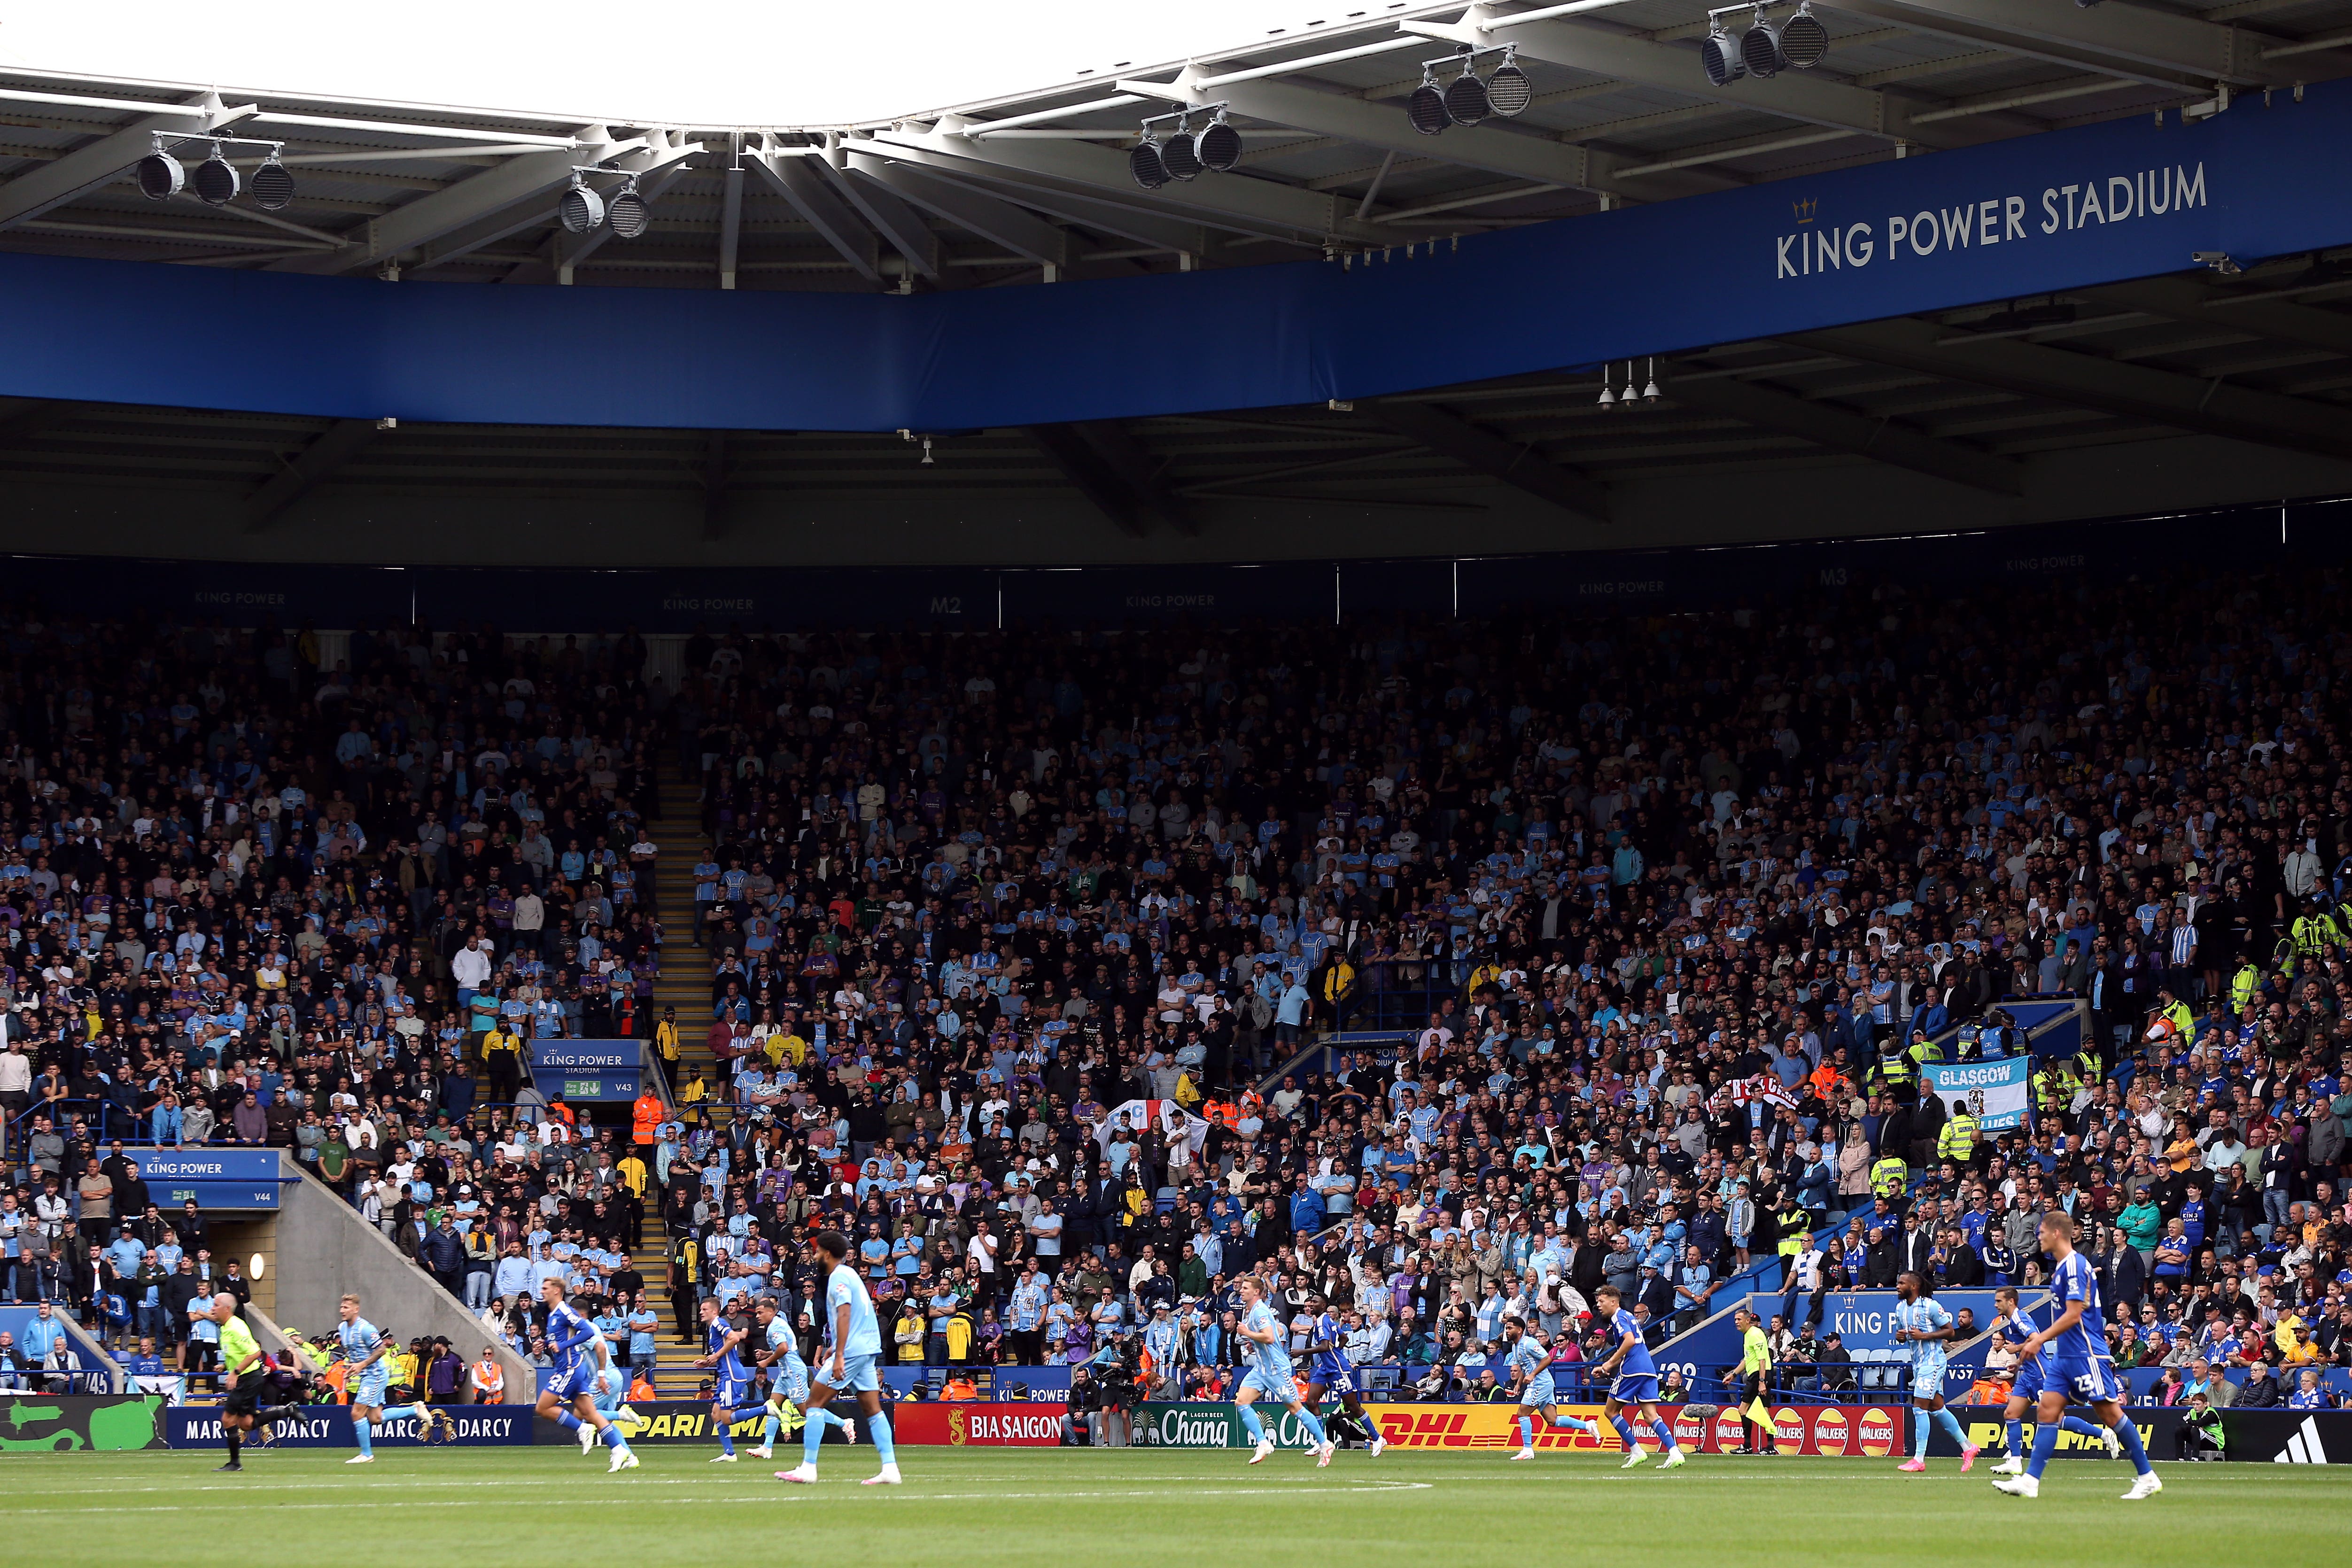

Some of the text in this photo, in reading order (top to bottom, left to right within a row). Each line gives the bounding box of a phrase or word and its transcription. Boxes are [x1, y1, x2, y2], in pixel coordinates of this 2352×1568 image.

[1777, 161, 2207, 279] KING POWER STADIUM
[2006, 555, 2085, 571] KING POWER
[1820, 567, 1847, 586] M3
[1579, 580, 1665, 595] KING POWER
[195, 592, 286, 605] KING POWER
[664, 599, 753, 609] KING POWER
[930, 596, 961, 613] M2
[1126, 594, 1214, 607] KING POWER
[543, 1056, 622, 1065] KING POWER
[1939, 1065, 2010, 1087] GLASGOW
[146, 1163, 222, 1174] KING POWER
[254, 1193, 271, 1201] V44
[1835, 1312, 1882, 1334] KING
[1333, 1378, 1347, 1391] 25
[1916, 1377, 1933, 1391] 45
[2074, 1373, 2096, 1393] 23
[719, 1391, 726, 1403] 9
[1032, 1389, 1071, 1401] POWER
[277, 1419, 331, 1438] DARCY
[370, 1418, 512, 1438] MARC DARCY
[970, 1415, 1063, 1438] BIA SAIGON
[1161, 1409, 1229, 1448] Chang
[1380, 1414, 1472, 1446] DHL
[1506, 1414, 1603, 1447] DHL
[1633, 1424, 1660, 1438] WALKE
[1717, 1424, 1745, 1438] WALKER
[1773, 1424, 1803, 1439] WALKERS
[1815, 1425, 1847, 1440] WALKERS
[1859, 1425, 1892, 1440] WALKERS
